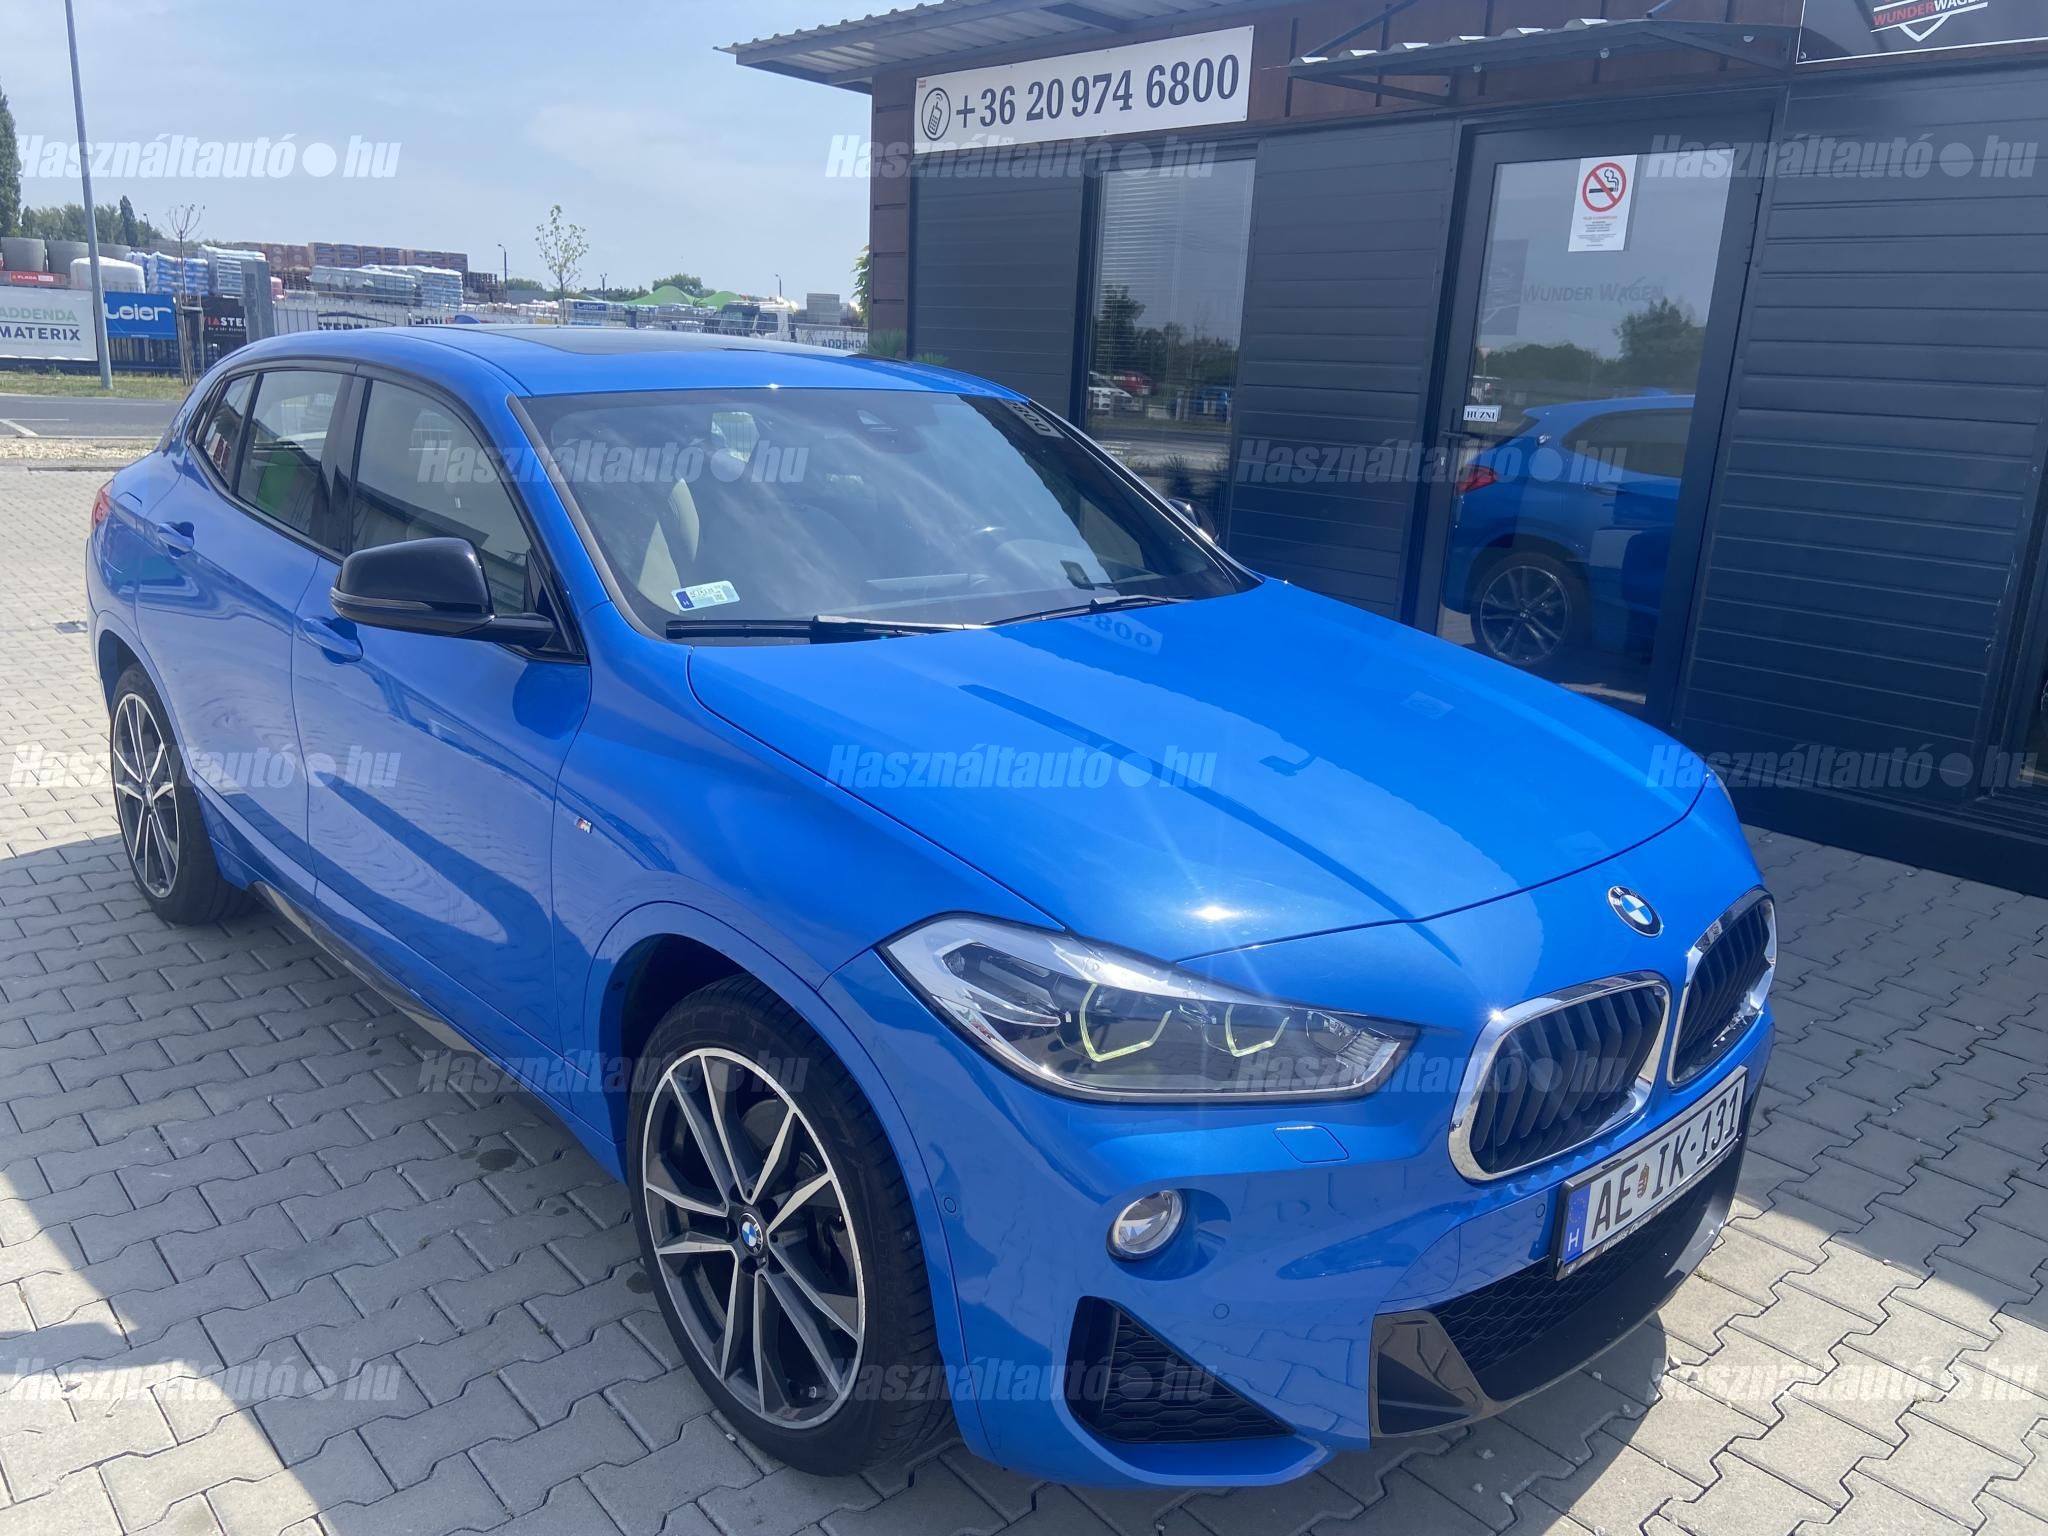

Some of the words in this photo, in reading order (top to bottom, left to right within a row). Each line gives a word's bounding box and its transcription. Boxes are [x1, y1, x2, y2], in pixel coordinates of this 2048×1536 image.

[956, 85, 1016, 128] +36
[1026, 78, 1064, 121] 20
[1071, 69, 1133, 117] 974
[1146, 54, 1240, 109] 6800
[0, 306, 78, 321] ADDENDA
[0, 325, 80, 341] MATERIX
[1591, 1162, 1639, 1240] AE
[1568, 1227, 1580, 1252] H
